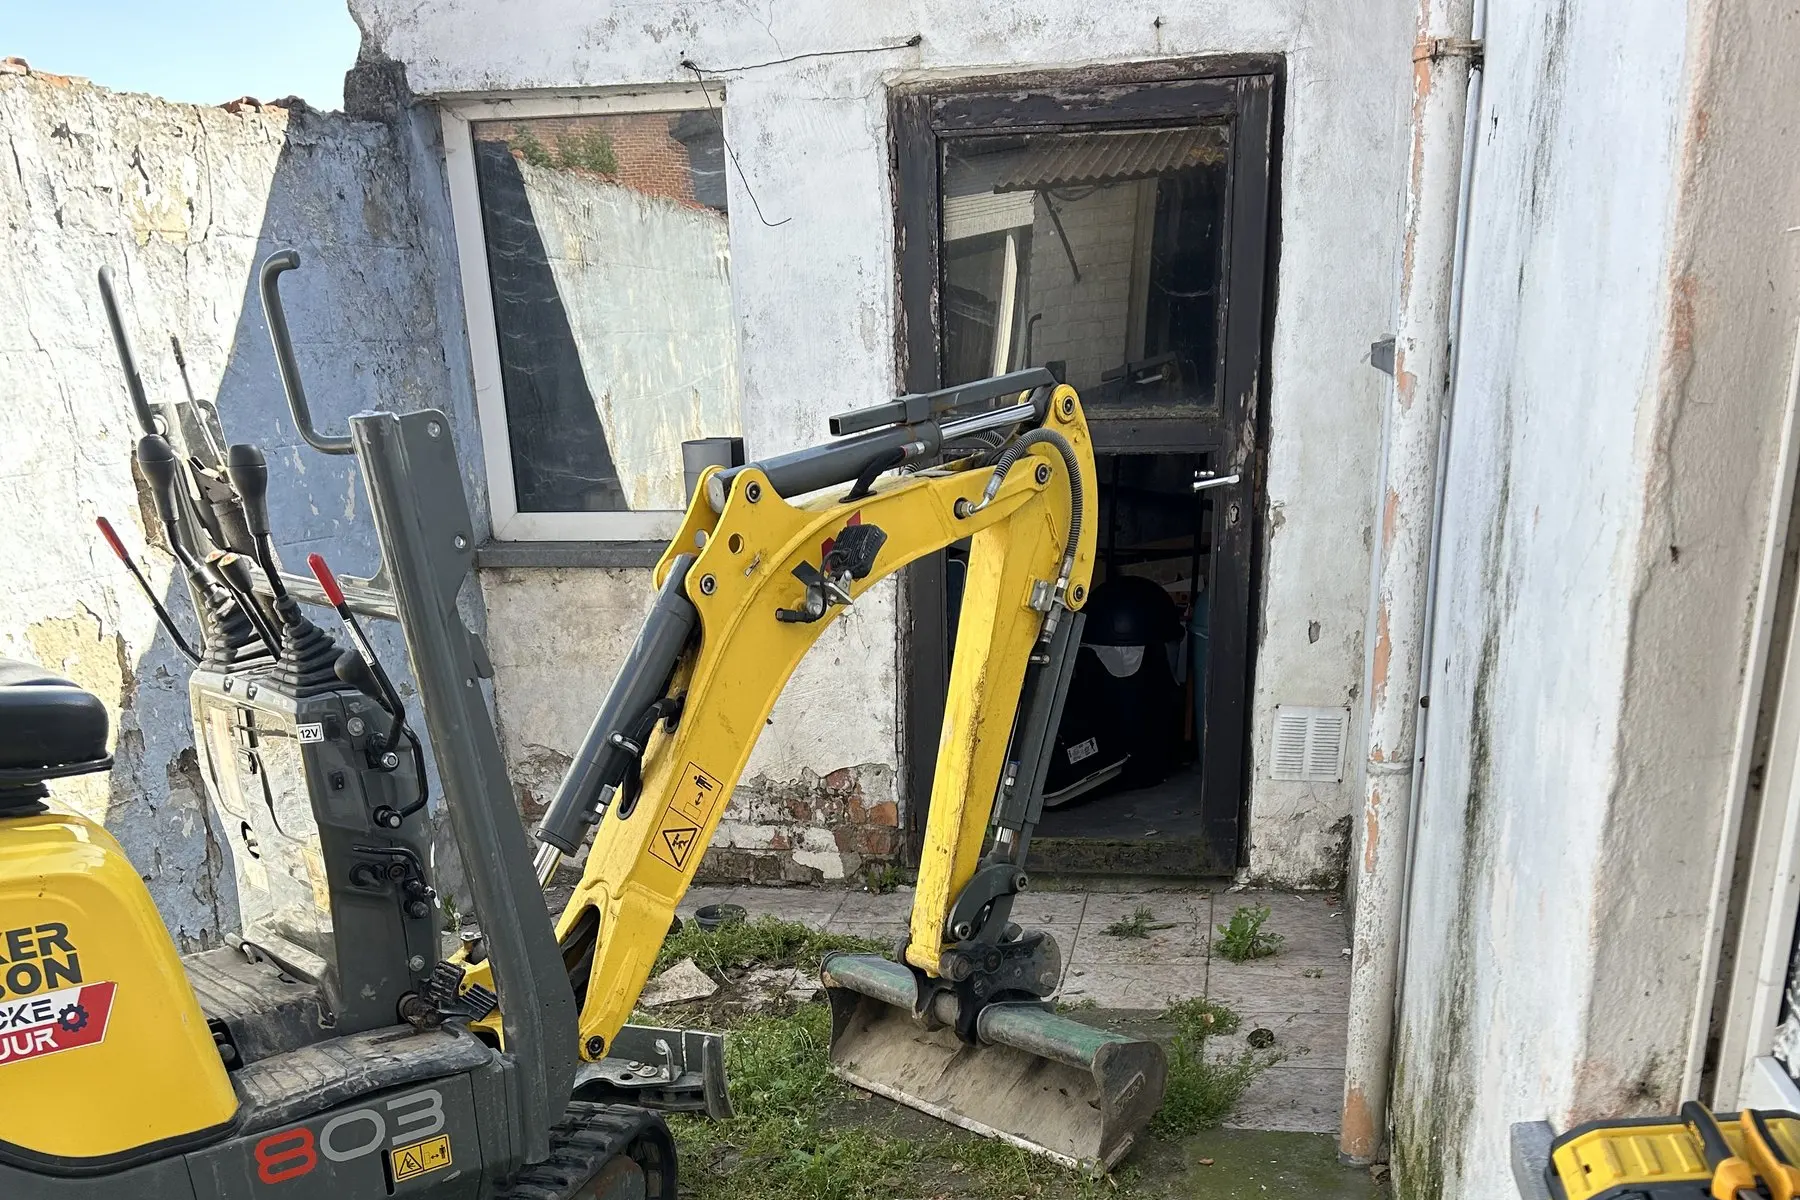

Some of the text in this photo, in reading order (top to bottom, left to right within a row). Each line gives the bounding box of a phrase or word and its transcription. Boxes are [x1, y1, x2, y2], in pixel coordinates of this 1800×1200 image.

[300, 728, 319, 739] 12V
[0, 922, 77, 965] ER
[0, 952, 83, 998] ON
[254, 1089, 445, 1185] 803
